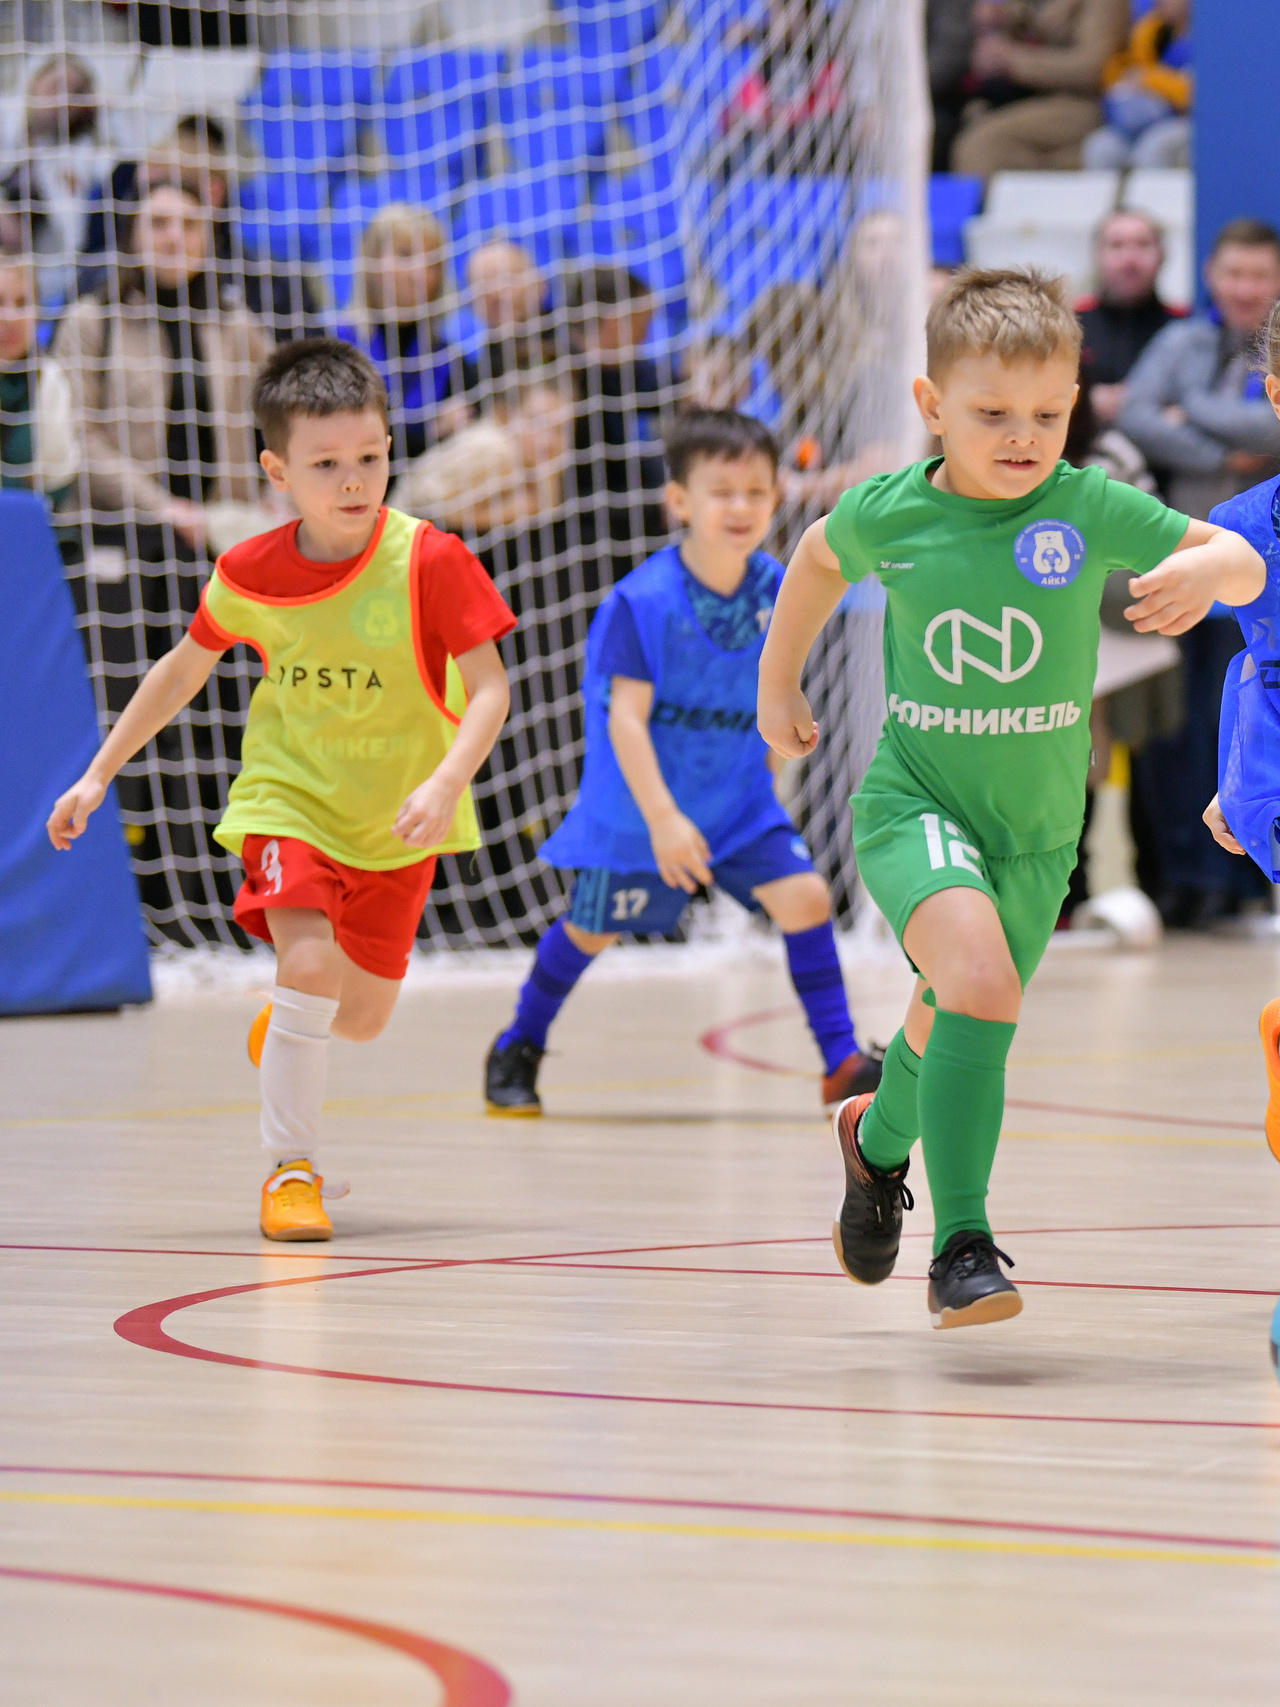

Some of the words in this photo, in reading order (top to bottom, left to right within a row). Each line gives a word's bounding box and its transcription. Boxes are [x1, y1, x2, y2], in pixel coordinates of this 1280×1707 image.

[1041, 575, 1067, 586] АЙКА
[265, 666, 382, 690] IPSTA
[651, 701, 757, 732] DEMI
[611, 888, 649, 920] 17
